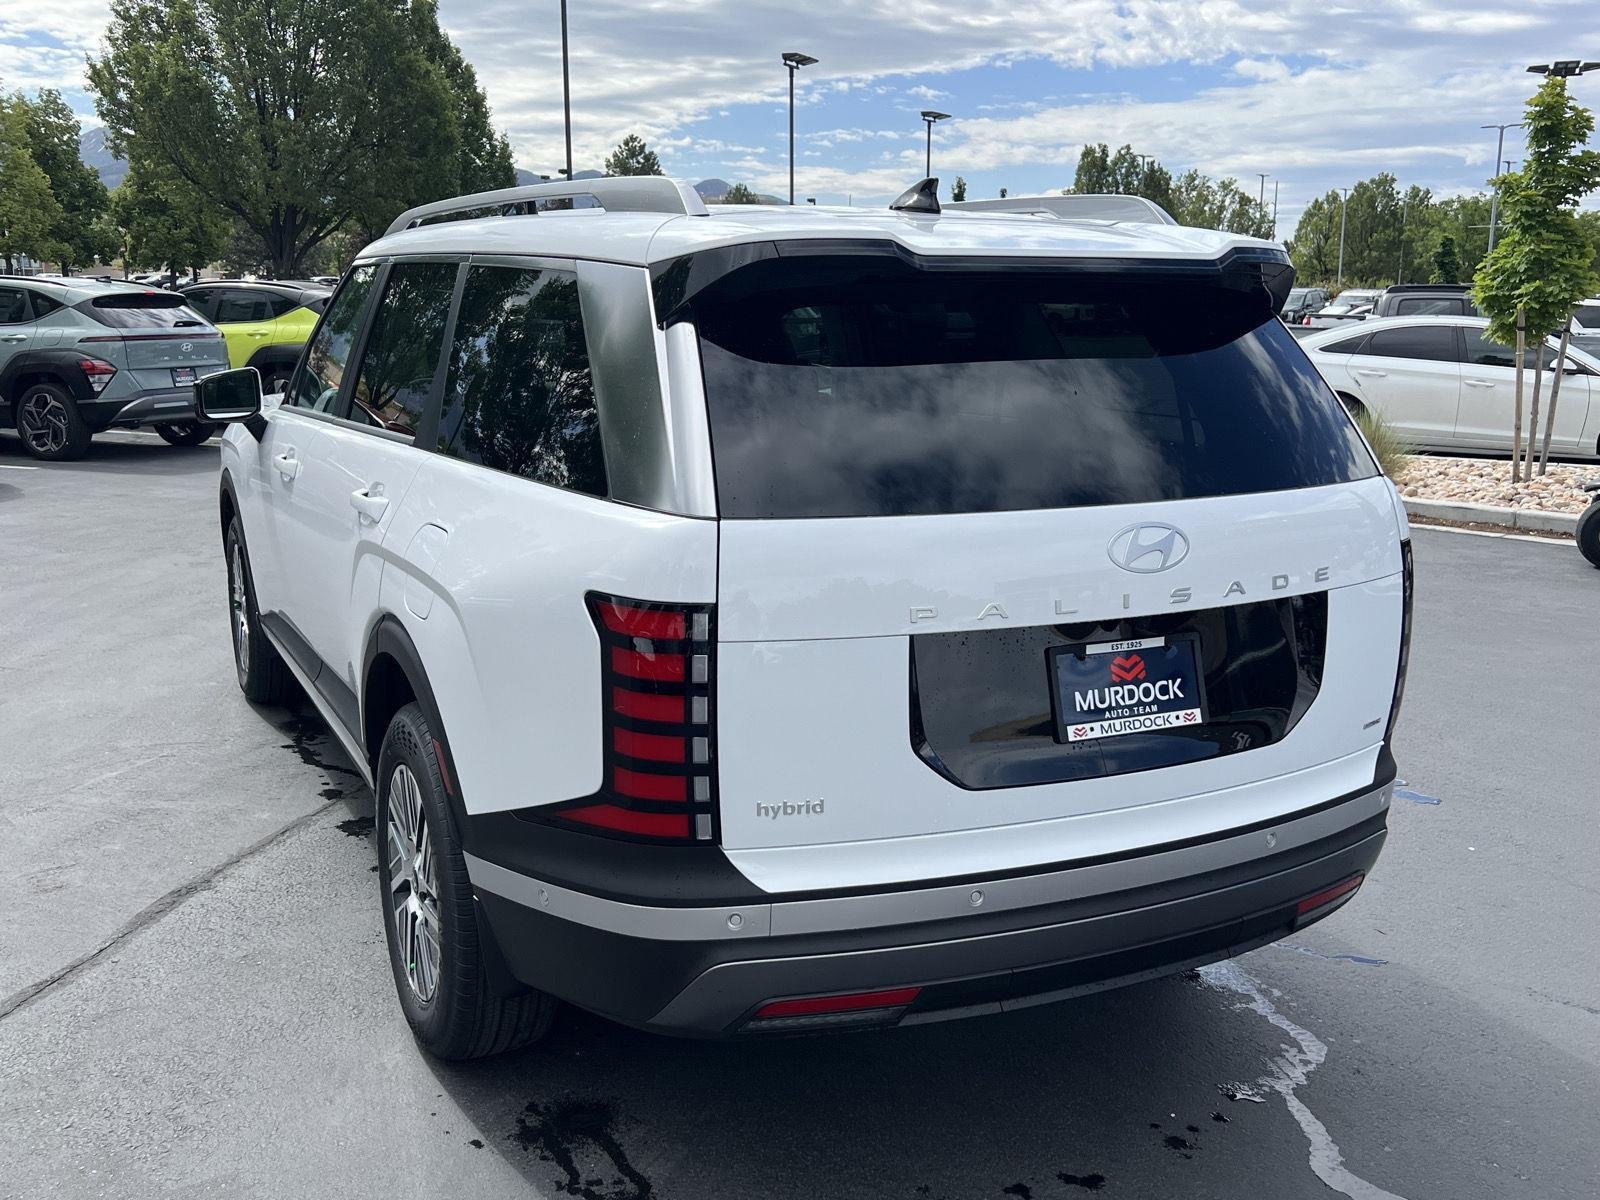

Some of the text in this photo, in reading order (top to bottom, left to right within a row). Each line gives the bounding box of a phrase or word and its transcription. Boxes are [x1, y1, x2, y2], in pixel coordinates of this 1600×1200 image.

[909, 567, 1330, 624] PALISADE
[1111, 640, 1143, 651] EST. 1925
[1074, 678, 1184, 712] MURDOCK
[1104, 704, 1158, 719] AUTO TEAM
[1100, 714, 1173, 735] MURDOCK
[756, 797, 825, 820] hybrid
